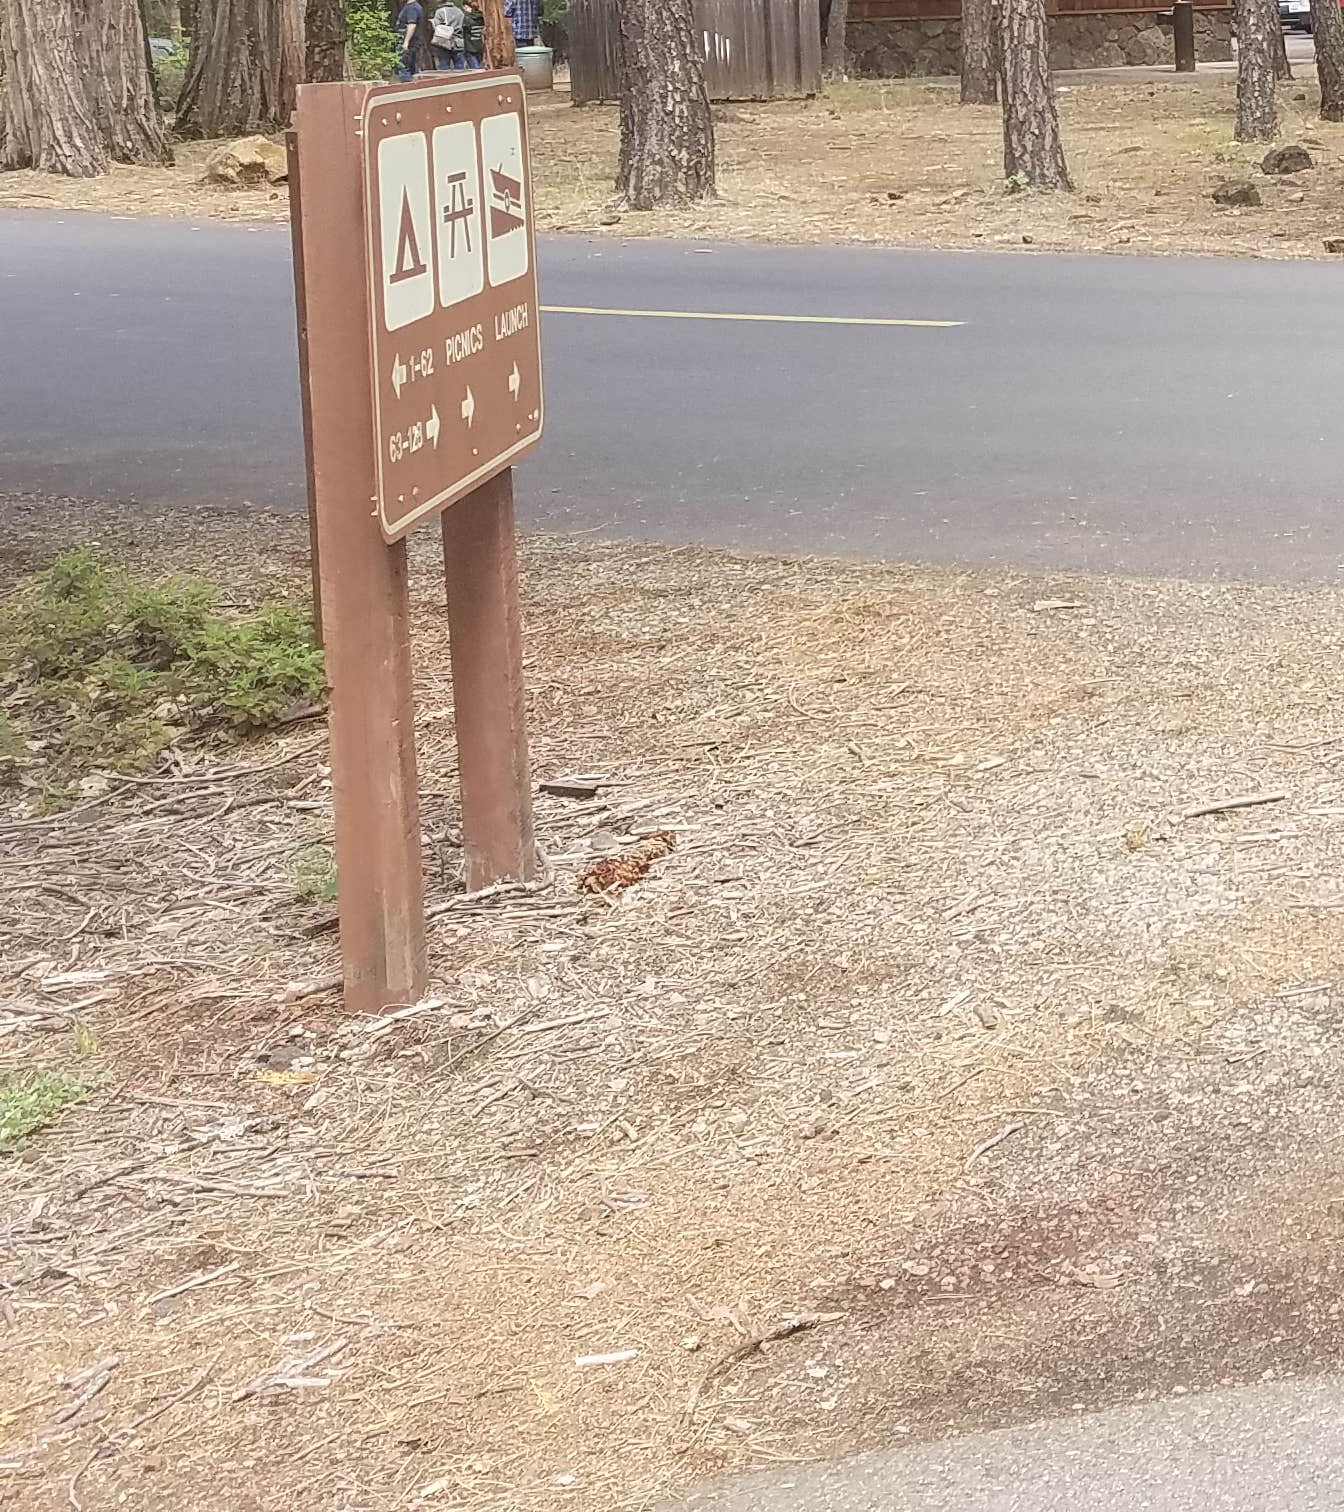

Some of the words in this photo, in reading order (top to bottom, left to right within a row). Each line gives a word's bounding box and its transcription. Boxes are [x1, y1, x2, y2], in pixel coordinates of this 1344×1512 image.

[494, 302, 528, 341] LAUNCH
[445, 323, 483, 365] PICNICS
[409, 348, 434, 382] 1-62
